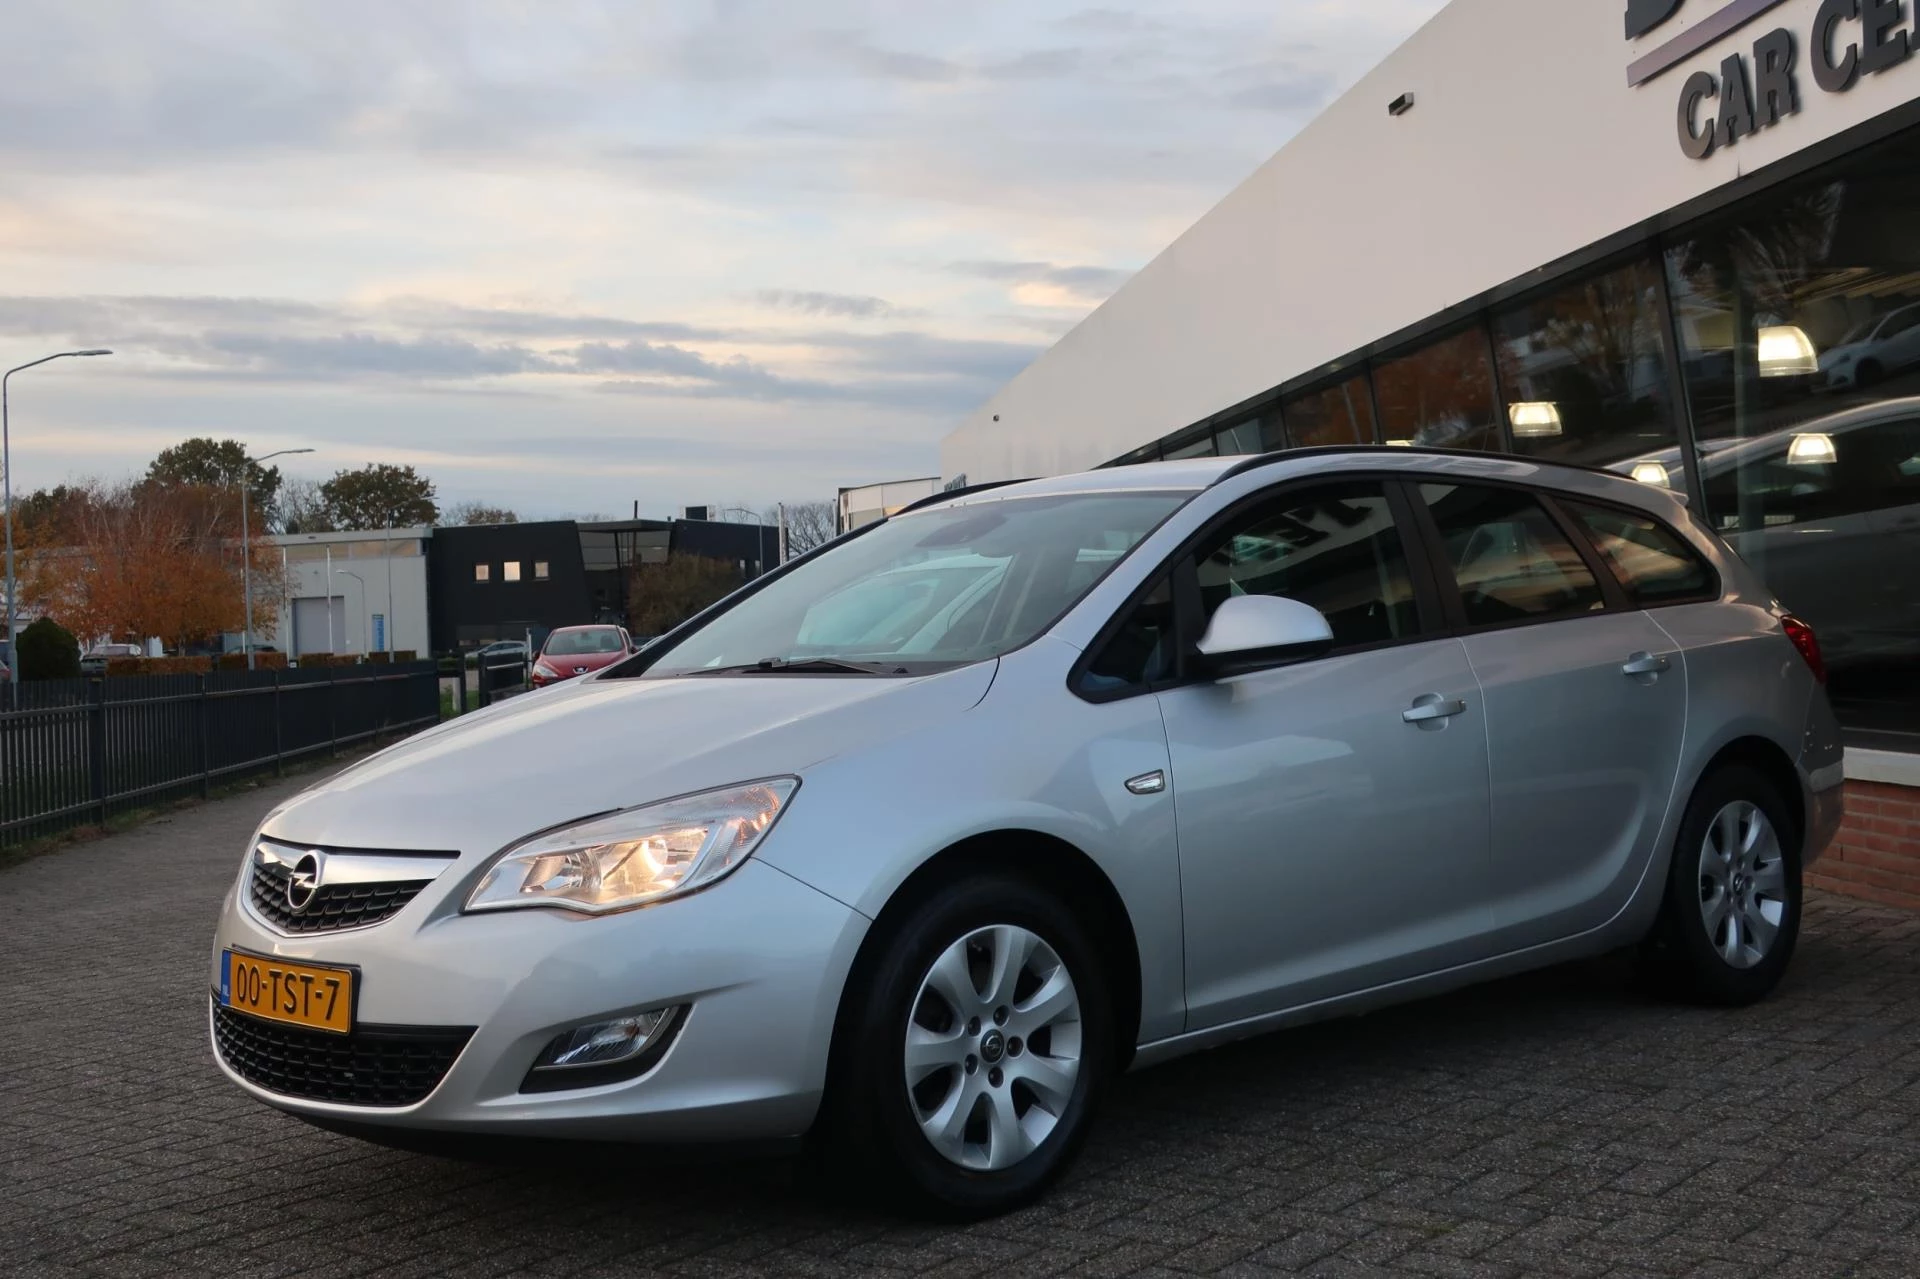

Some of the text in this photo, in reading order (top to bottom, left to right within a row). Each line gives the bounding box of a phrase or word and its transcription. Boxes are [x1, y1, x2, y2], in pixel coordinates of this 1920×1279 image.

[1677, 0, 1920, 159] CAR CE
[237, 963, 341, 1020] 00-TST-7
